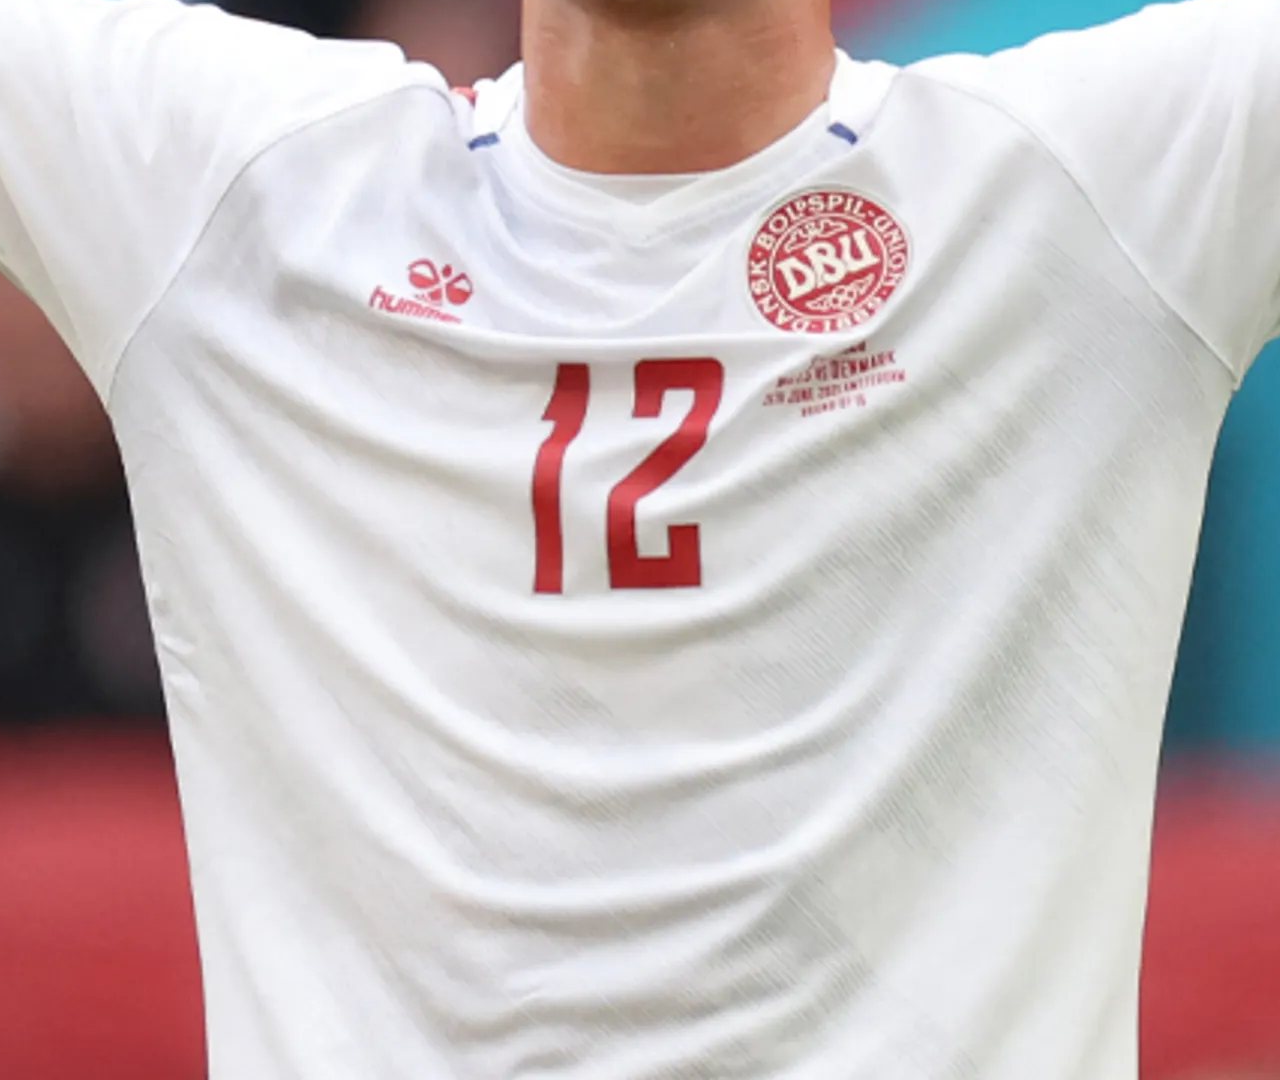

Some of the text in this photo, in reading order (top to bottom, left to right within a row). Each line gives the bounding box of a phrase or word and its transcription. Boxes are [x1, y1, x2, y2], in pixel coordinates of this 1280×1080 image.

[776, 228, 881, 301] DBU
[829, 350, 896, 381] DENMARK
[533, 358, 723, 593] 12
